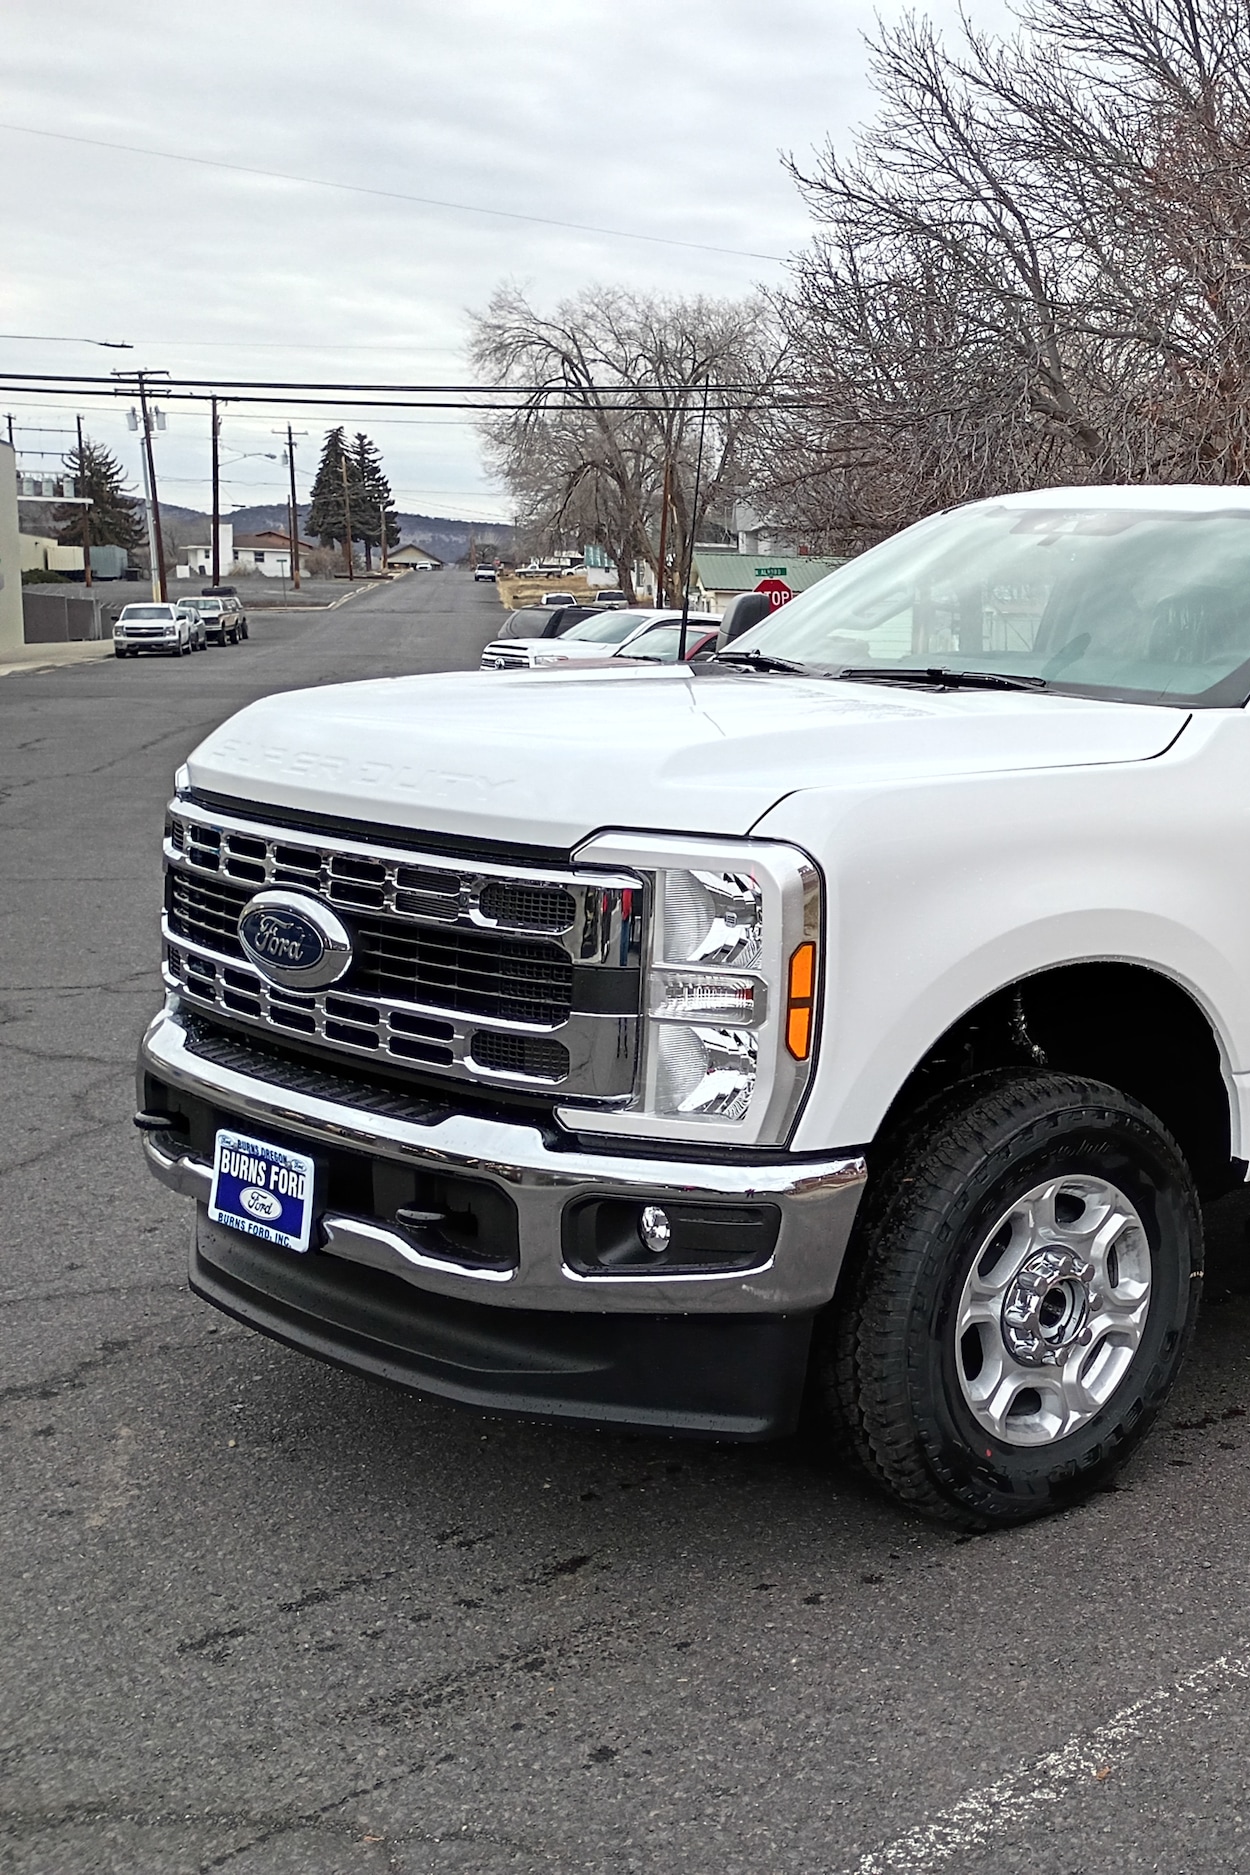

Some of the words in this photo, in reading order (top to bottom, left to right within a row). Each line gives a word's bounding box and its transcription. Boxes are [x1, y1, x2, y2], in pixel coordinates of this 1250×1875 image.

[764, 590, 790, 605] TOP
[254, 915, 305, 961] Ford
[237, 1139, 260, 1156] BURNS
[260, 1147, 288, 1164] OREGON
[221, 1148, 267, 1186] BURNS
[269, 1165, 305, 1200] FORD
[247, 1191, 273, 1215] Ford
[218, 1212, 246, 1231] BURNS
[275, 1232, 292, 1248] INC.
